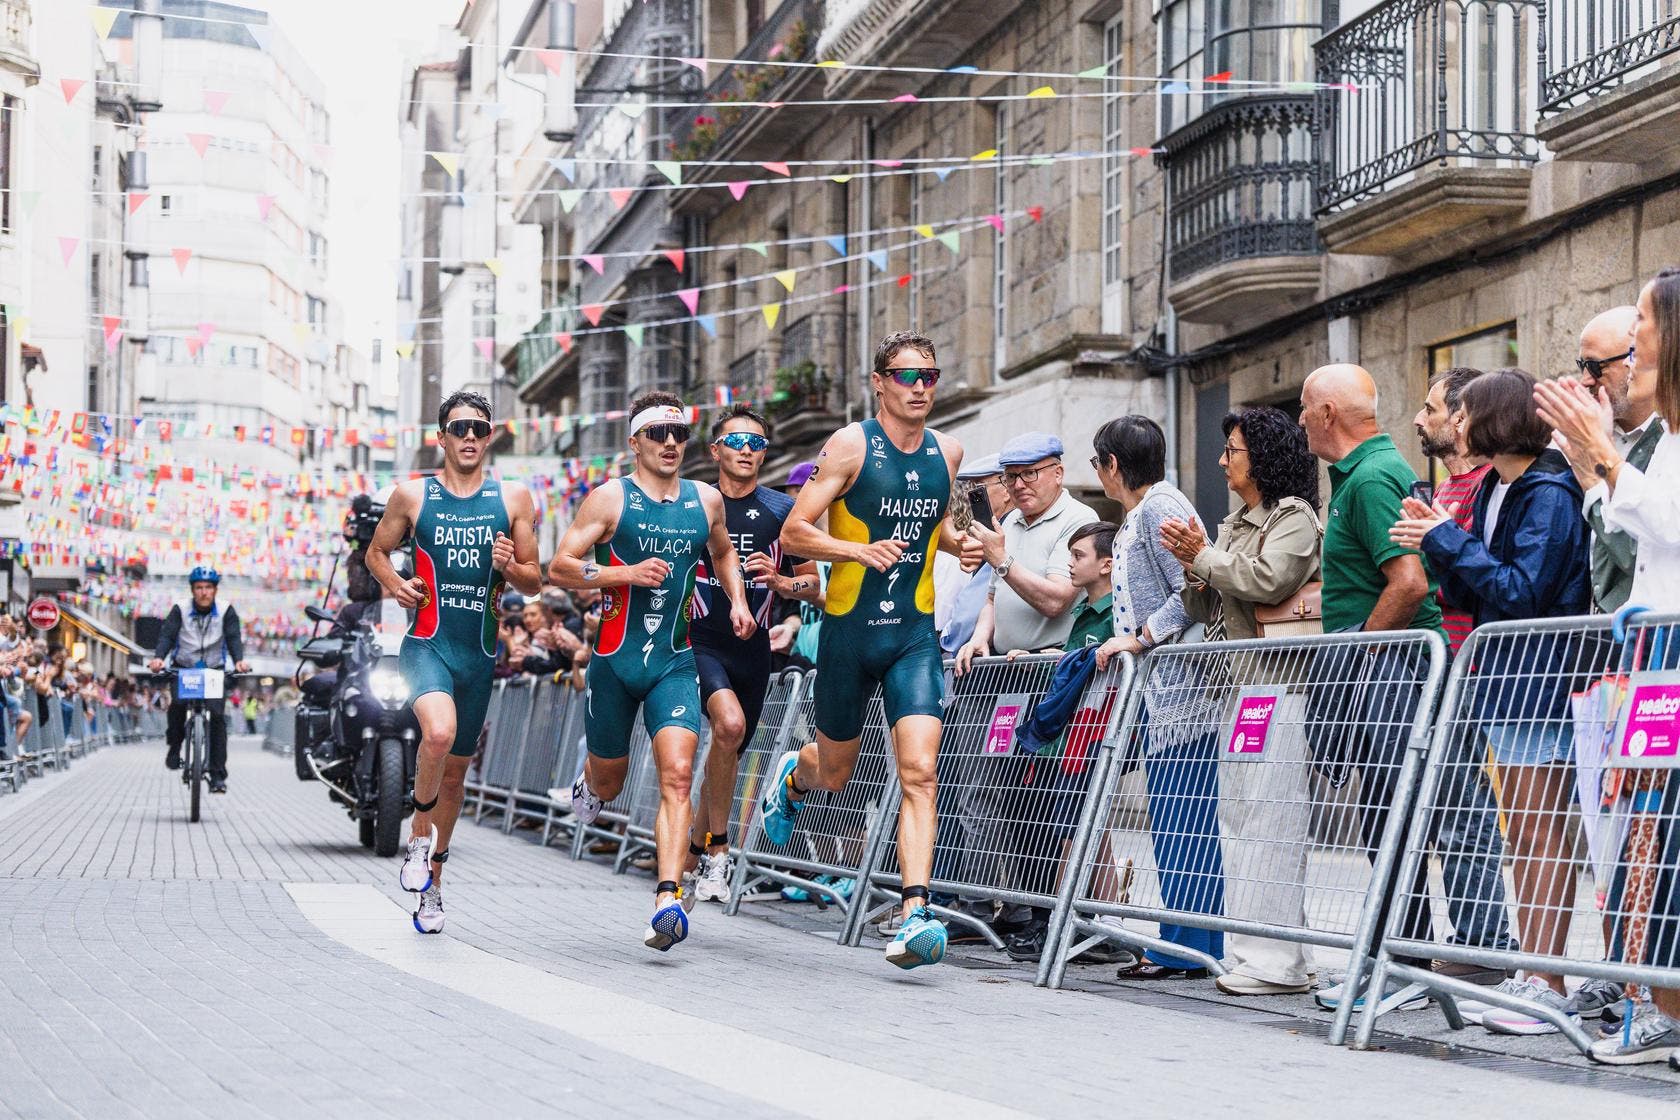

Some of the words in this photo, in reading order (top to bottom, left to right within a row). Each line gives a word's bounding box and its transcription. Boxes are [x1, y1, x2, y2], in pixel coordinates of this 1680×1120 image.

[907, 482, 919, 491] AIS
[879, 497, 939, 518] HAUSER
[446, 513, 458, 521] CA
[434, 525, 495, 546] BATISTA
[648, 523, 661, 532] CA
[890, 521, 922, 541] AUS
[638, 536, 692, 558] VILAÇA
[447, 548, 480, 568] POR
[898, 552, 923, 563] SICS
[441, 583, 476, 592] SPONSER
[441, 596, 485, 613] HUUB
